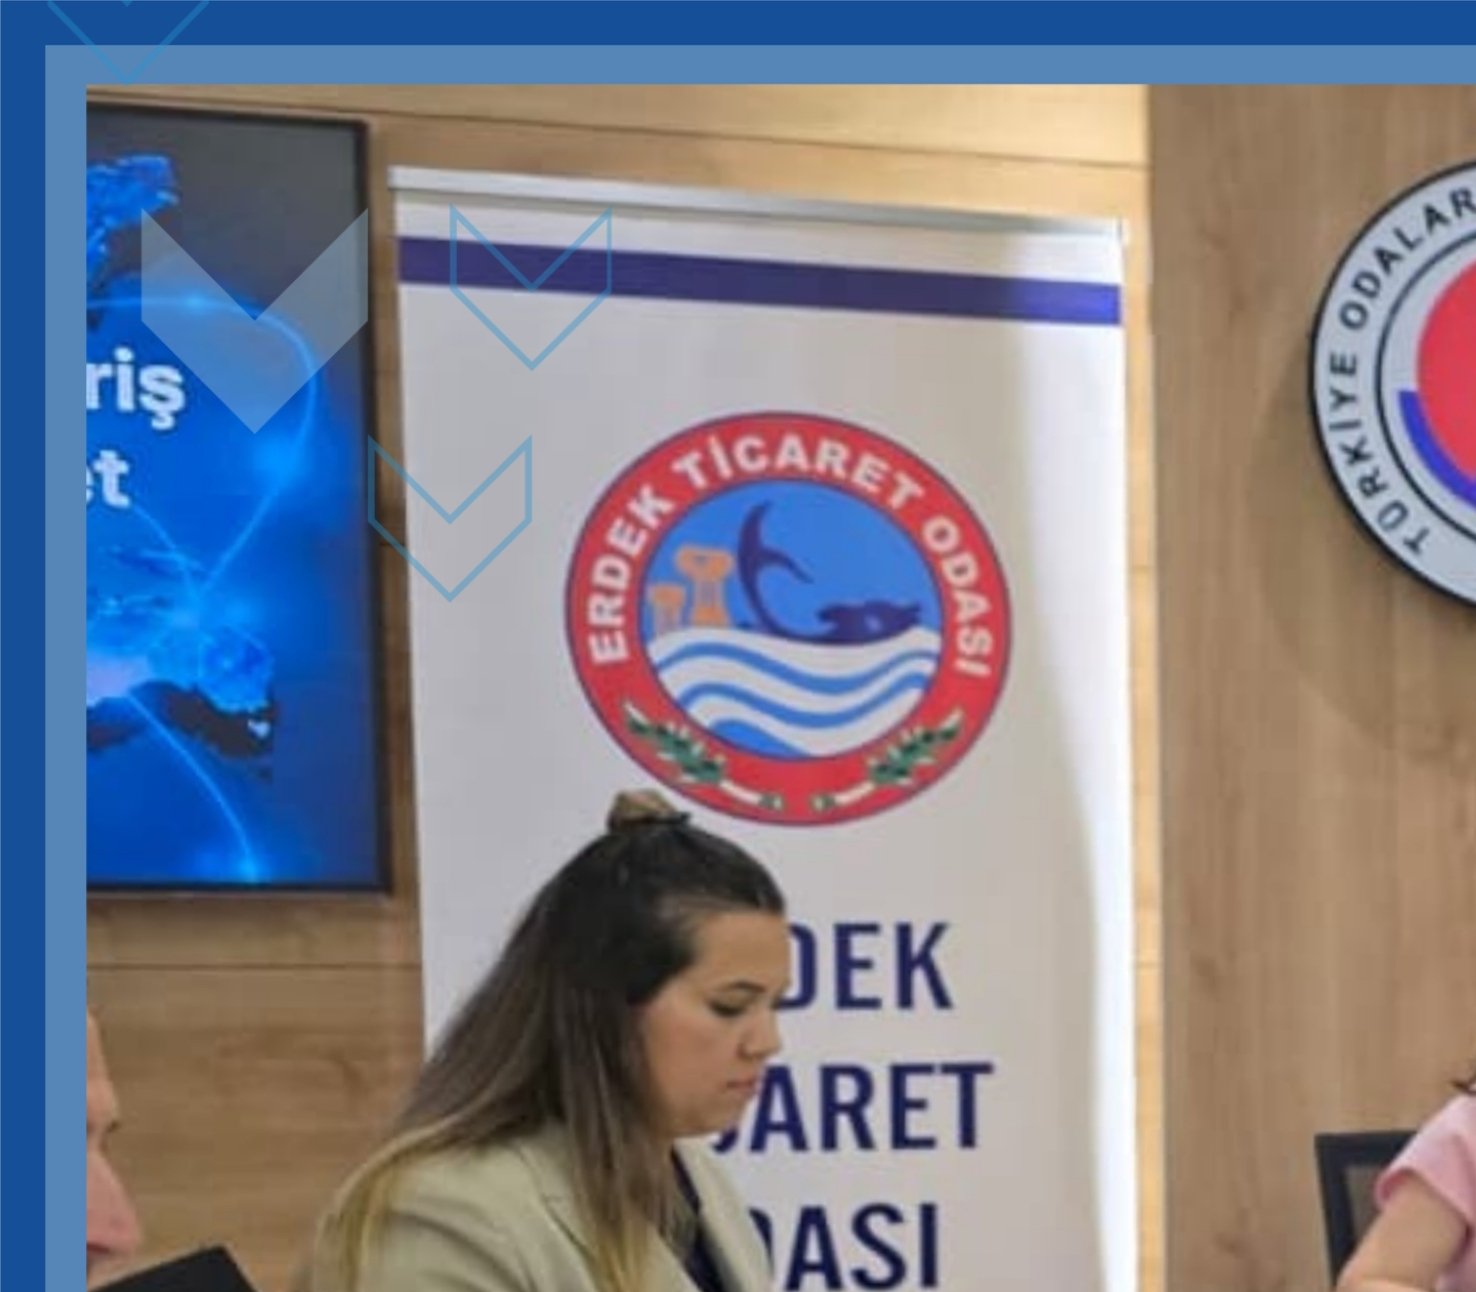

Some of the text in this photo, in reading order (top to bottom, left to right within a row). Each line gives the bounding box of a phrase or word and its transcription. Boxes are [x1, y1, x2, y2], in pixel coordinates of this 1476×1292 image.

[1329, 353, 1430, 556] TÜRKİYE
[587, 434, 993, 678] ERDEK TİCARET ODASI
[776, 921, 955, 1010] DEK
[711, 1062, 994, 1153] ARET
